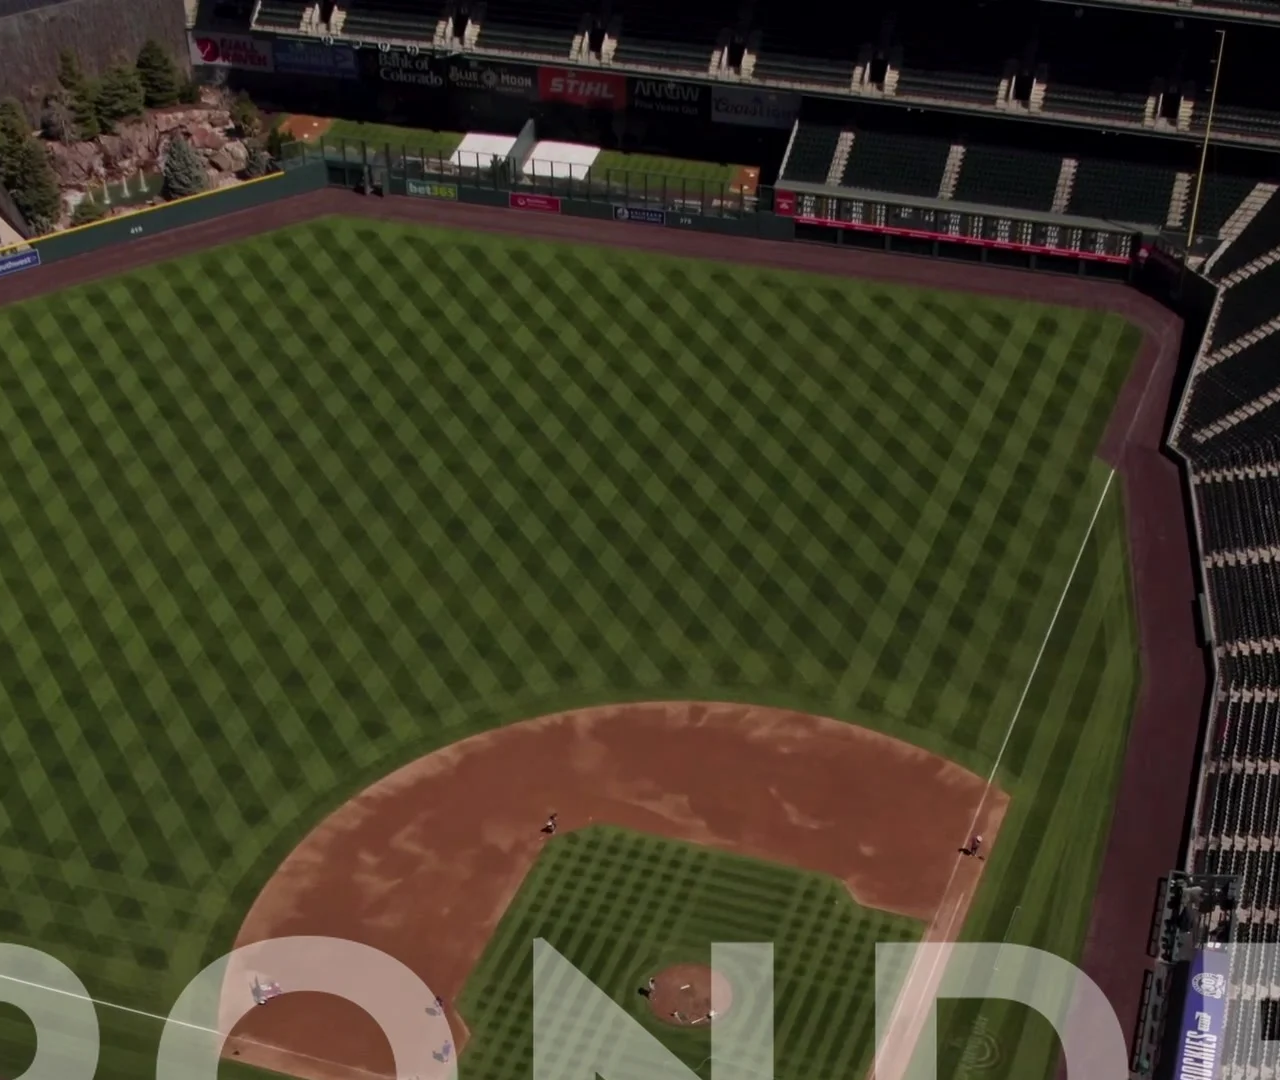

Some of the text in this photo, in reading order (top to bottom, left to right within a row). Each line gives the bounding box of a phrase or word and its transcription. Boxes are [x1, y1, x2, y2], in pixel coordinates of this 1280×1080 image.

[378, 51, 430, 71] Bank of
[379, 67, 443, 87] Colorado
[500, 72, 532, 87] MOON
[550, 77, 616, 98] STIHL
[408, 182, 455, 198] bet365
